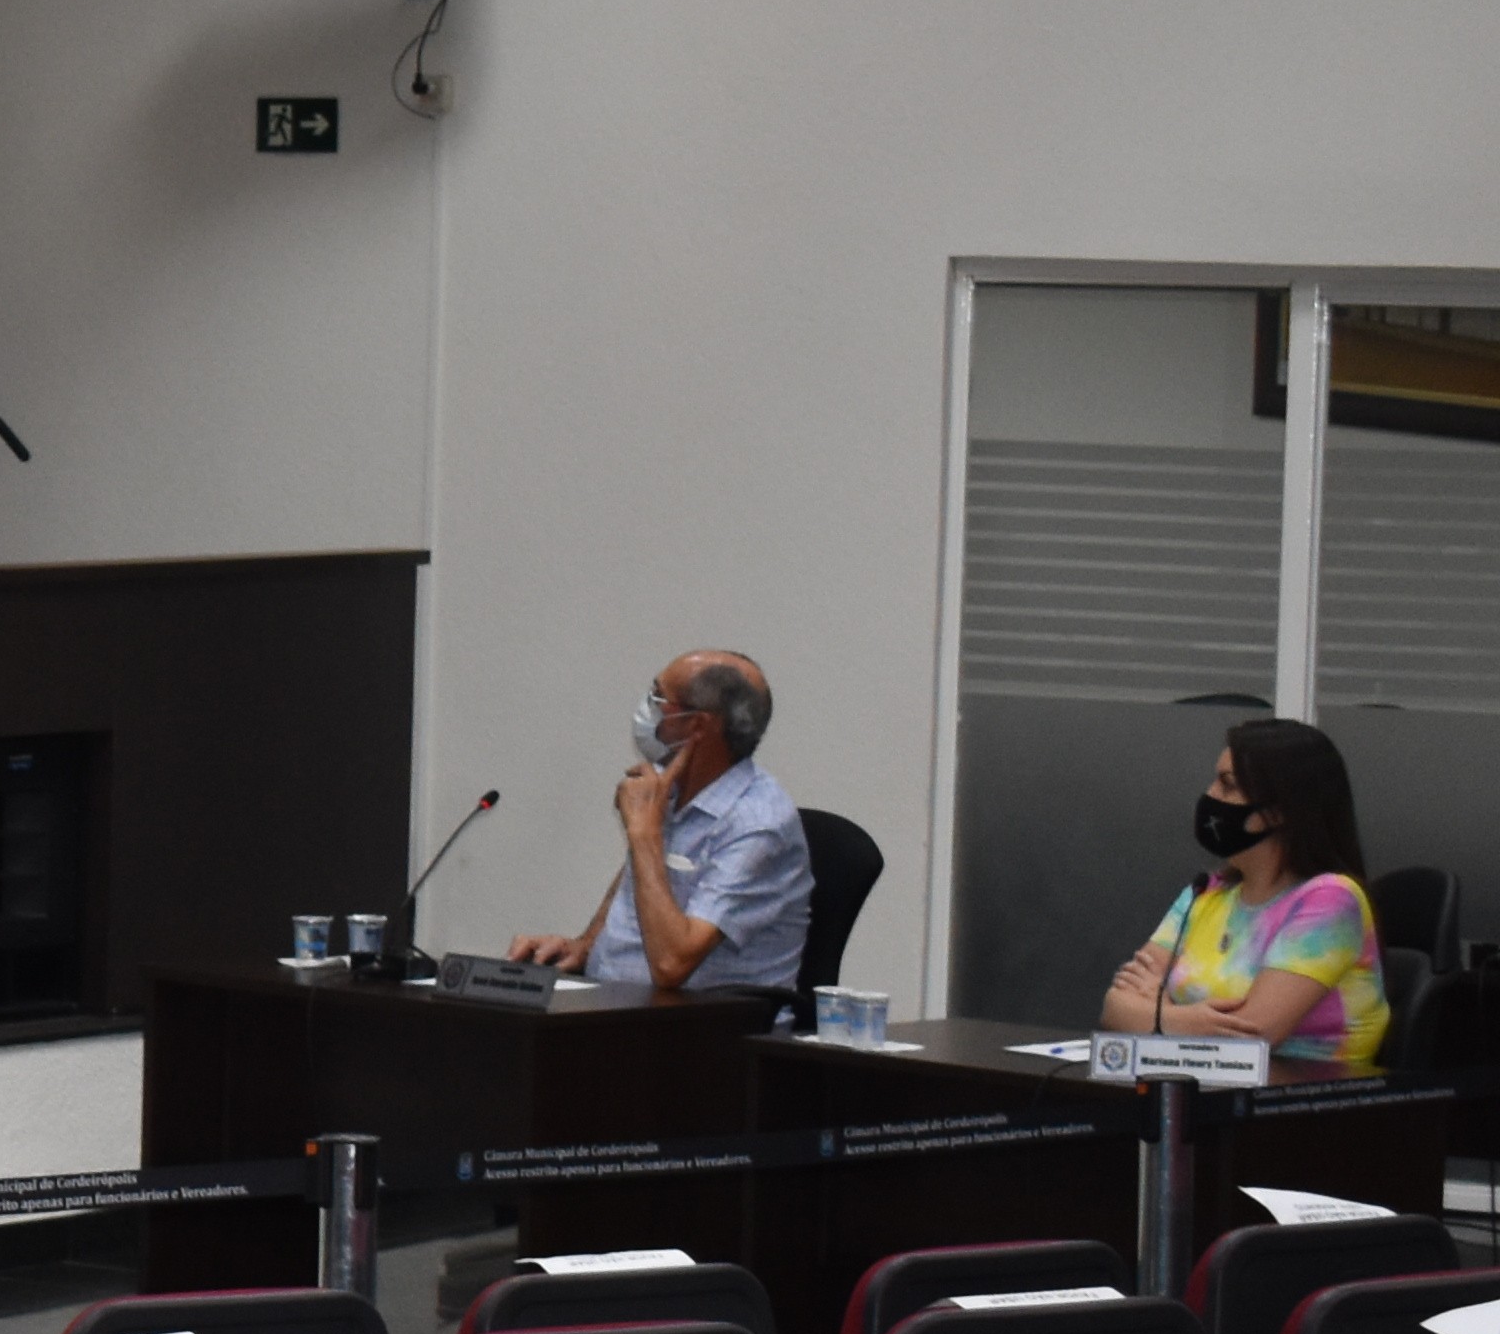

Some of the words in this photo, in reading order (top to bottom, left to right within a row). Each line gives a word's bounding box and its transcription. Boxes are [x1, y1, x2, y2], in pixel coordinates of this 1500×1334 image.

[40, 1177, 54, 1189] de
[57, 1172, 137, 1188] Cordeirópolis
[21, 1198, 64, 1212] apenas
[66, 1194, 93, 1209] para
[95, 1189, 169, 1205] funcionários
[172, 1190, 179, 1199] e
[181, 1183, 248, 1198] Vereadores.
